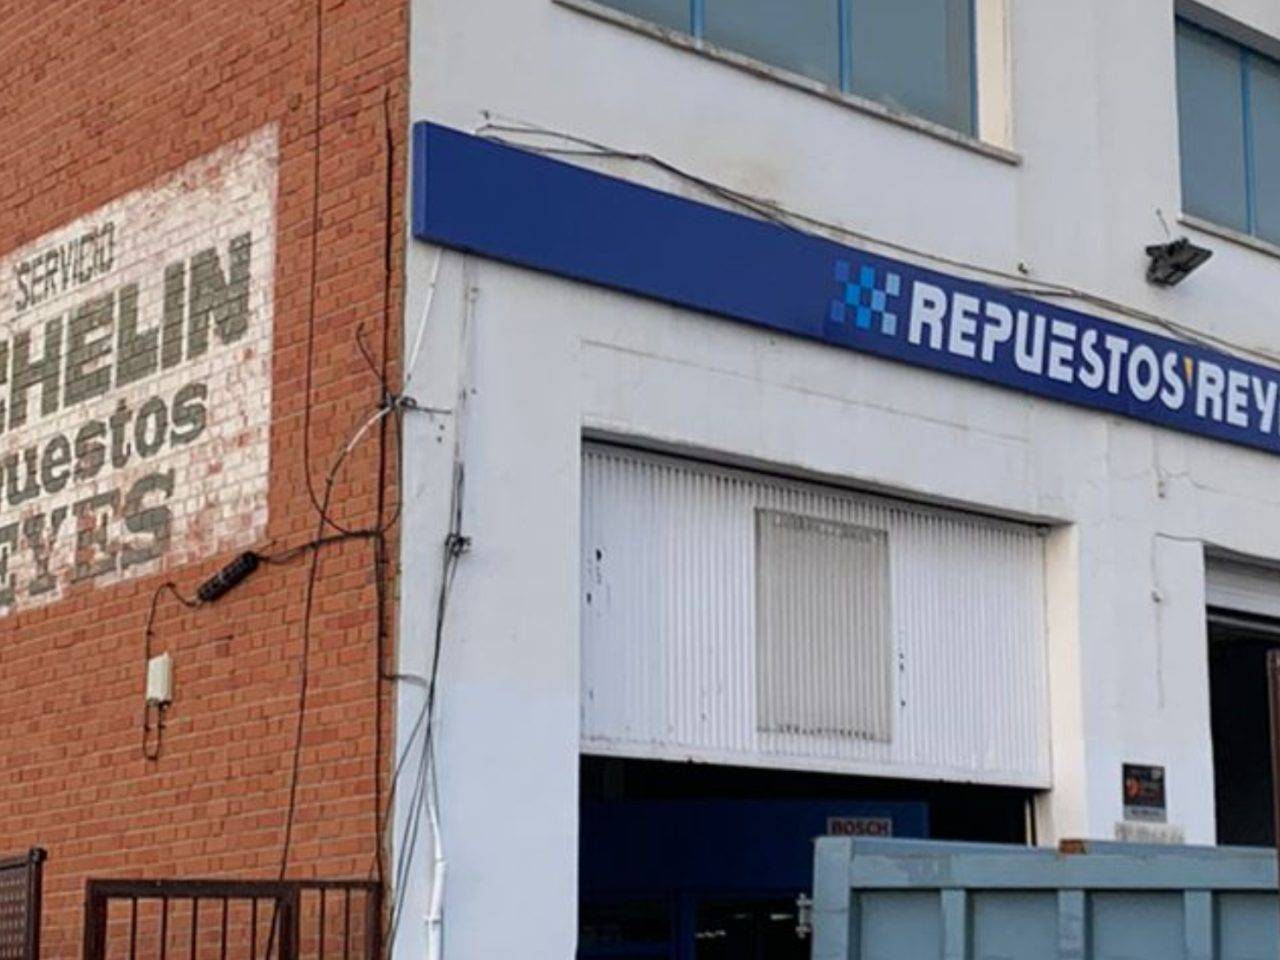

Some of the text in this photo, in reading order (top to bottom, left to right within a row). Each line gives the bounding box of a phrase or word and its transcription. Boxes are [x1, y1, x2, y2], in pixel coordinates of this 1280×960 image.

[0, 232, 251, 433] HELIN
[907, 280, 1185, 410] REPUESTOS
[0, 383, 209, 506] uestos
[832, 819, 889, 837] BOSCH
